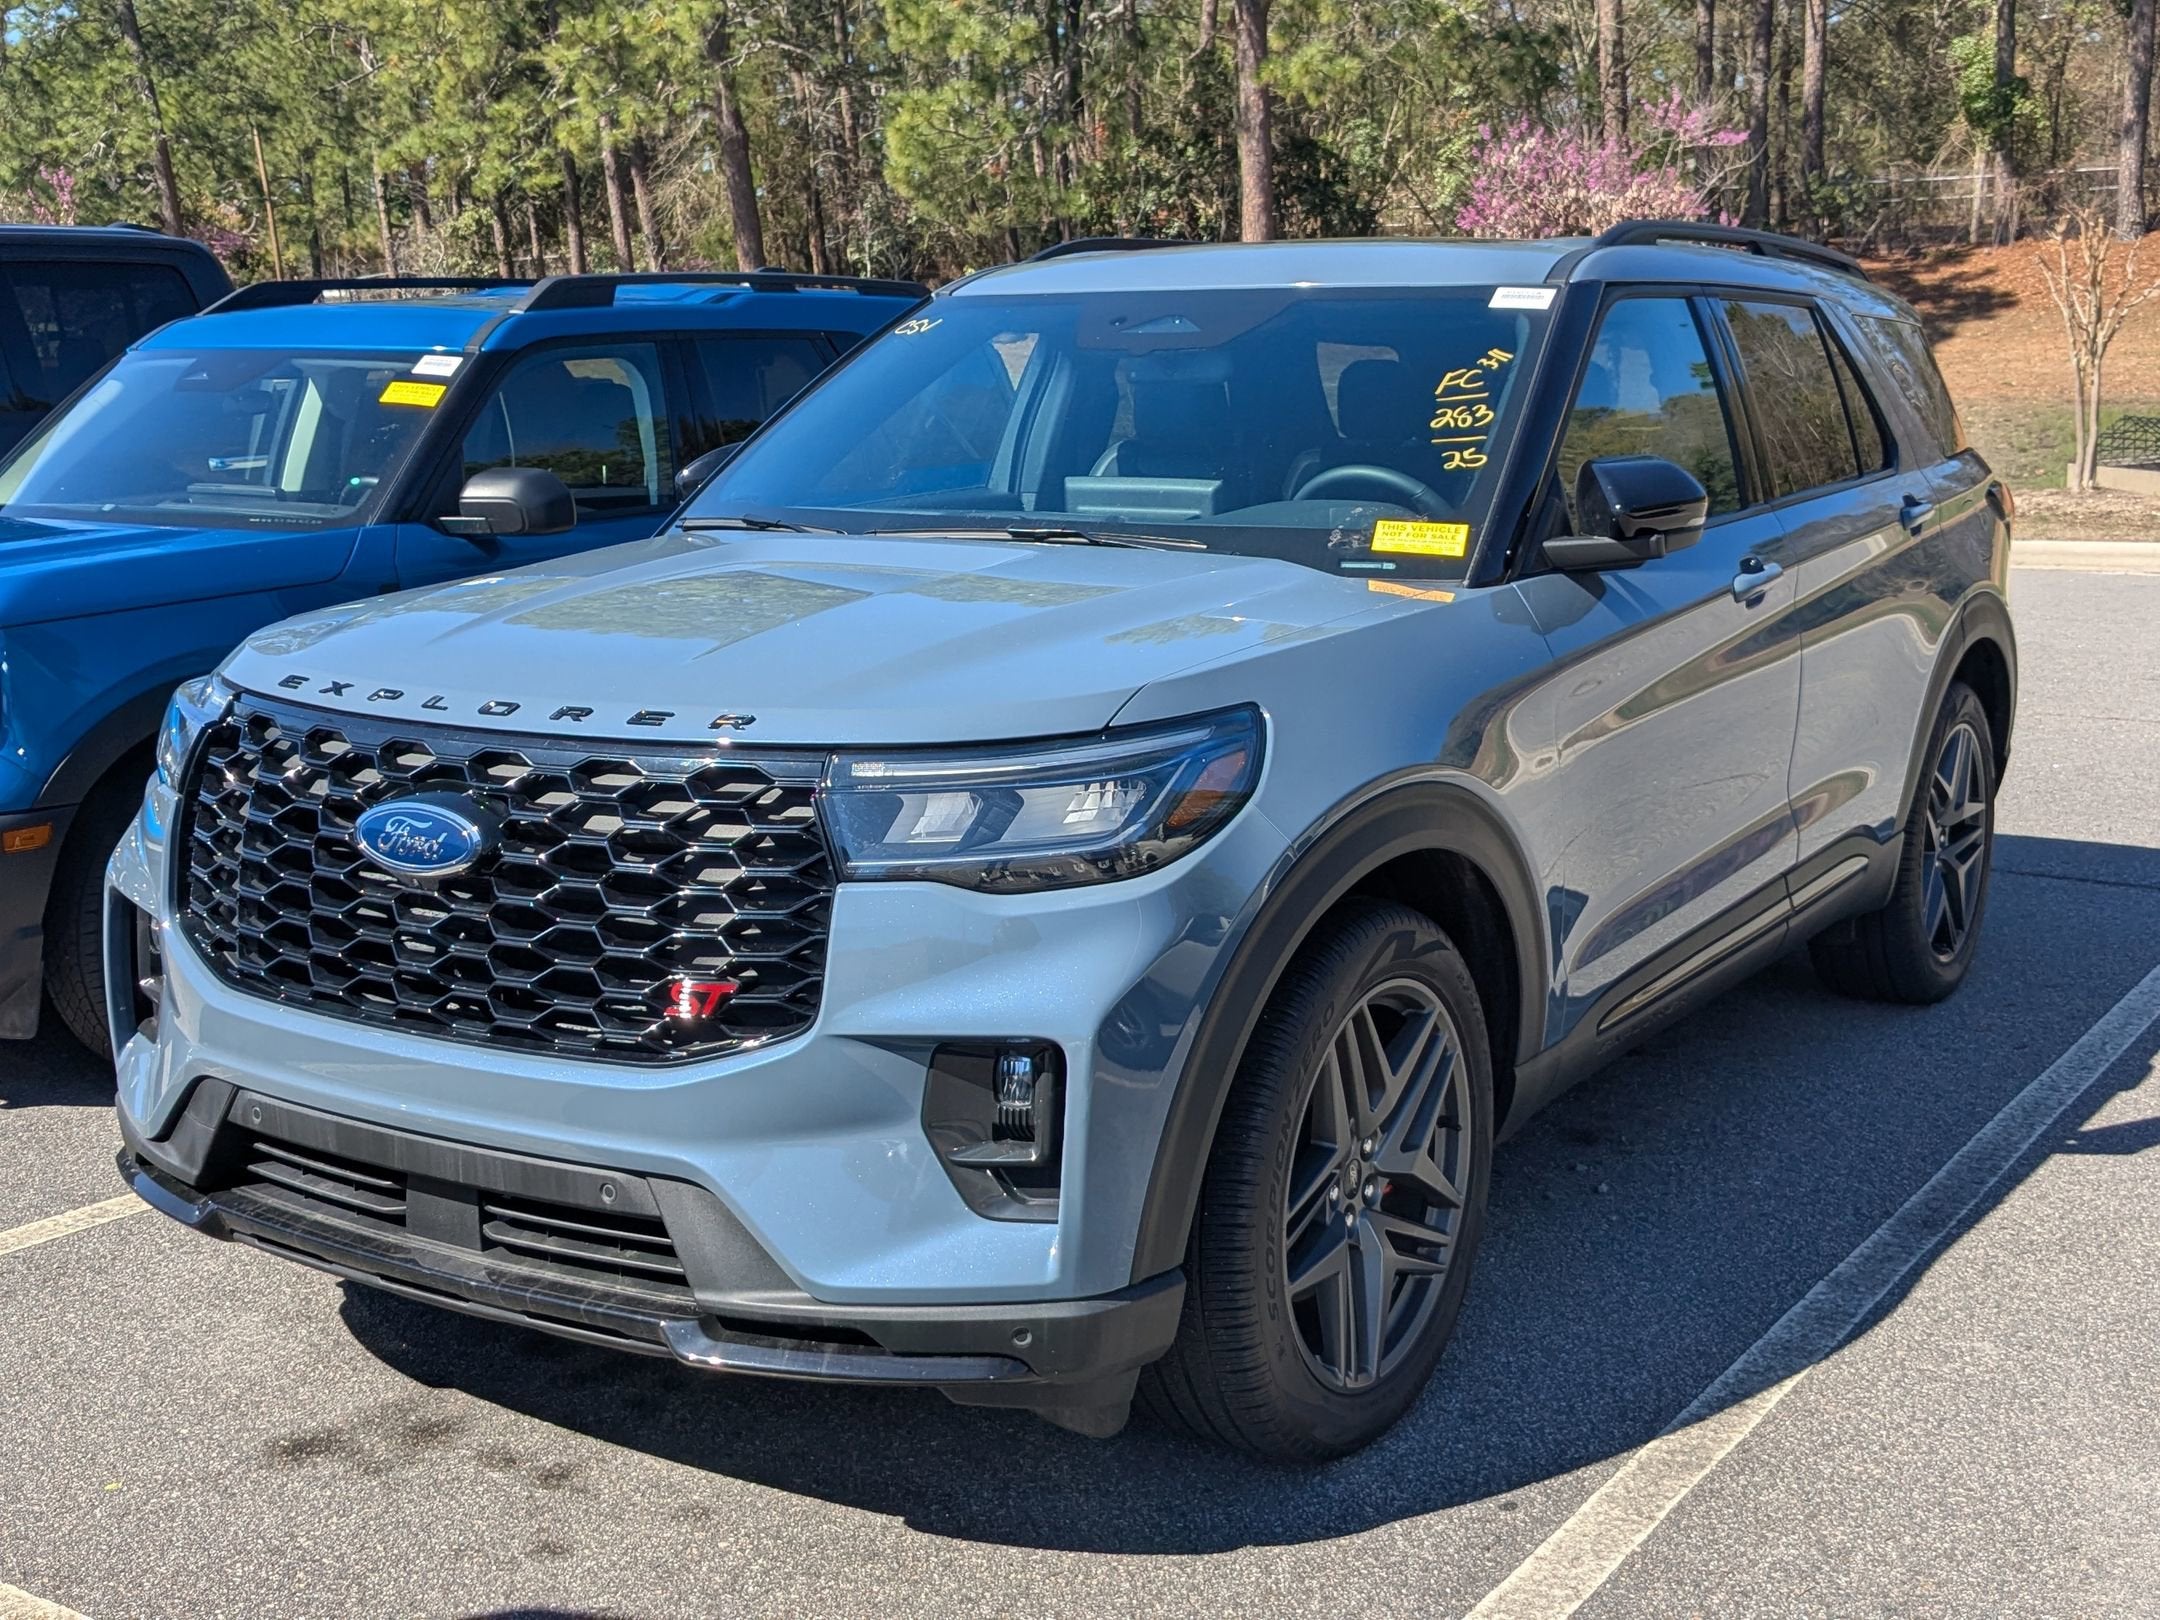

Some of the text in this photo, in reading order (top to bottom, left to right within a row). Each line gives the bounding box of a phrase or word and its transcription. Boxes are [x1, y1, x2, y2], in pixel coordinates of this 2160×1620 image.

[1435, 368, 1484, 395] FC
[1430, 404, 1495, 428] 283
[1441, 447, 1488, 470] 25
[1381, 523, 1462, 534] THIS VEHICLE
[1431, 533, 1457, 541] SALE
[278, 674, 757, 731] EXPLORER
[378, 815, 448, 860] Ford
[664, 981, 739, 1019] ST
